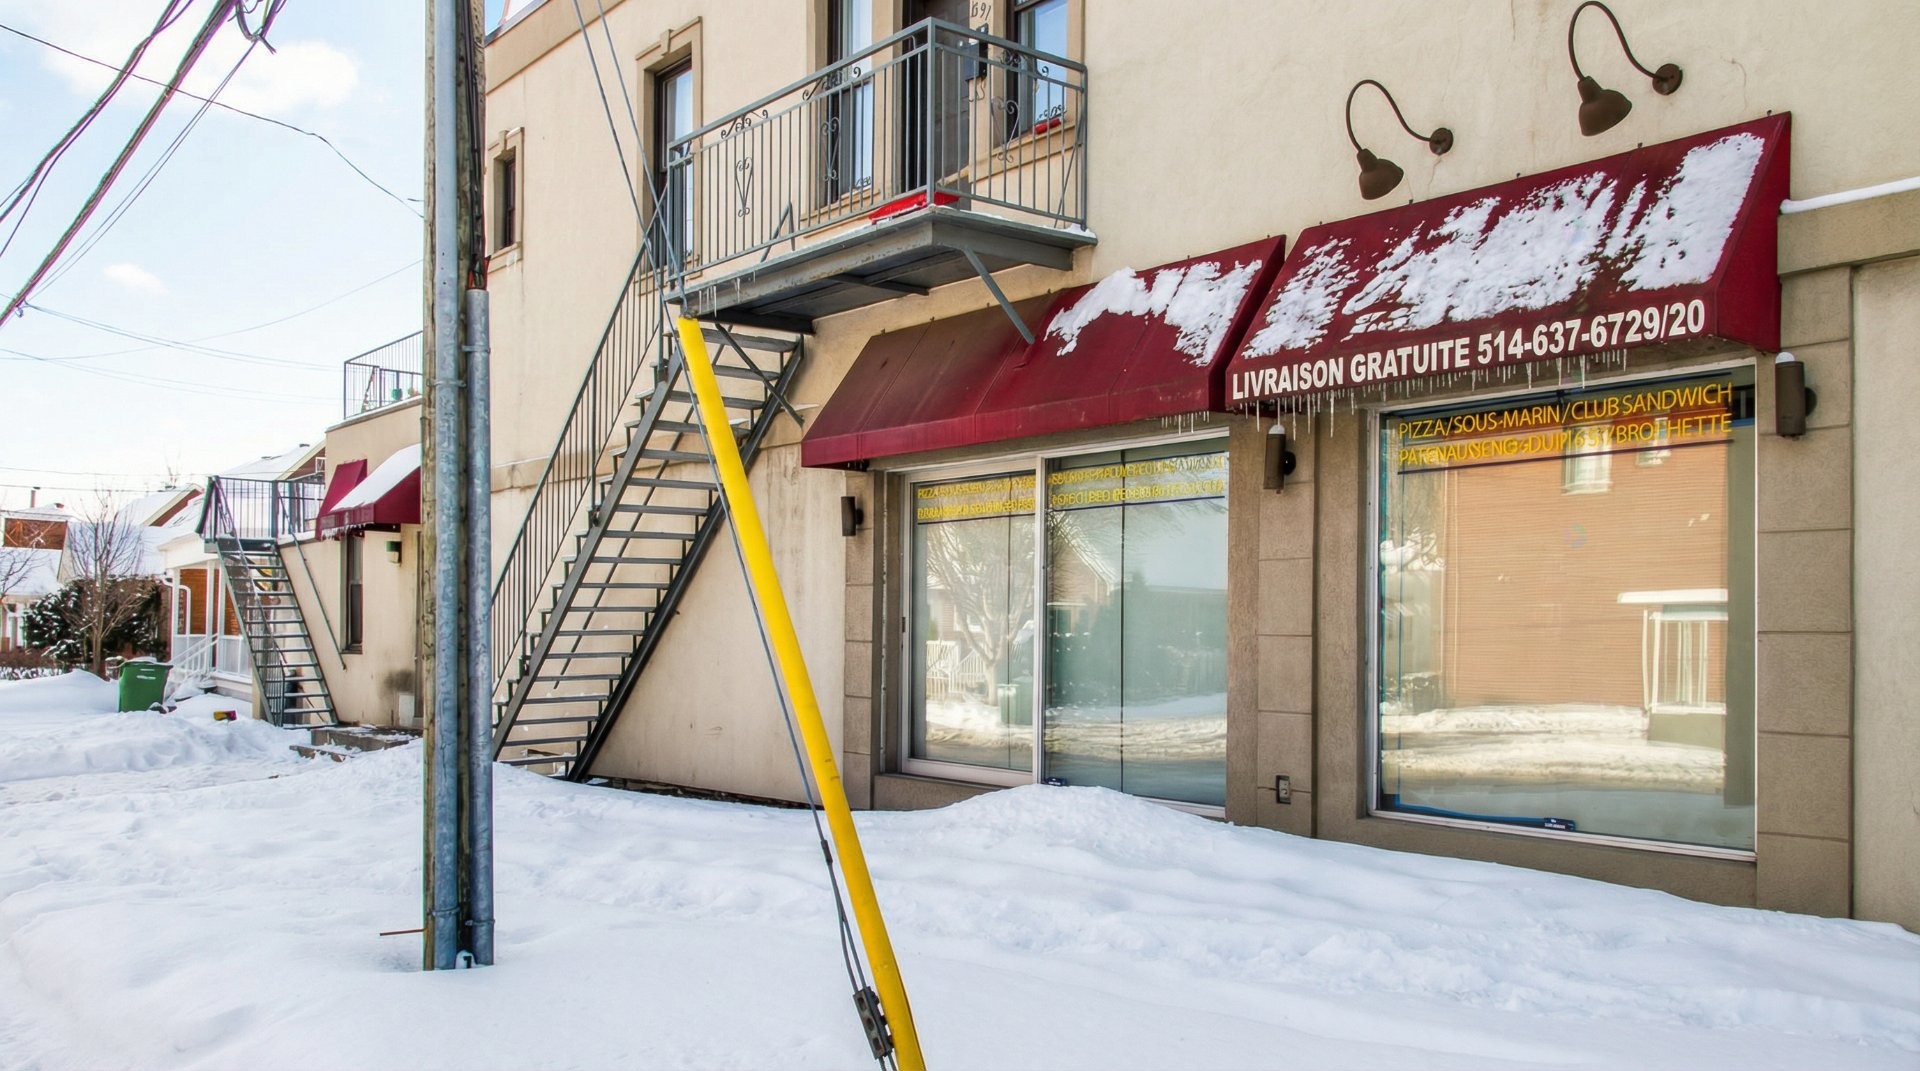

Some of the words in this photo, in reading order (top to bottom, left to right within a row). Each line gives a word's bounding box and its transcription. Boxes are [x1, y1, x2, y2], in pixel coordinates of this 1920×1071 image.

[1232, 357, 1344, 400] LIVRAISON
[1349, 337, 1470, 383] GRATUITE
[1477, 299, 1705, 365] 514-637-6729/20
